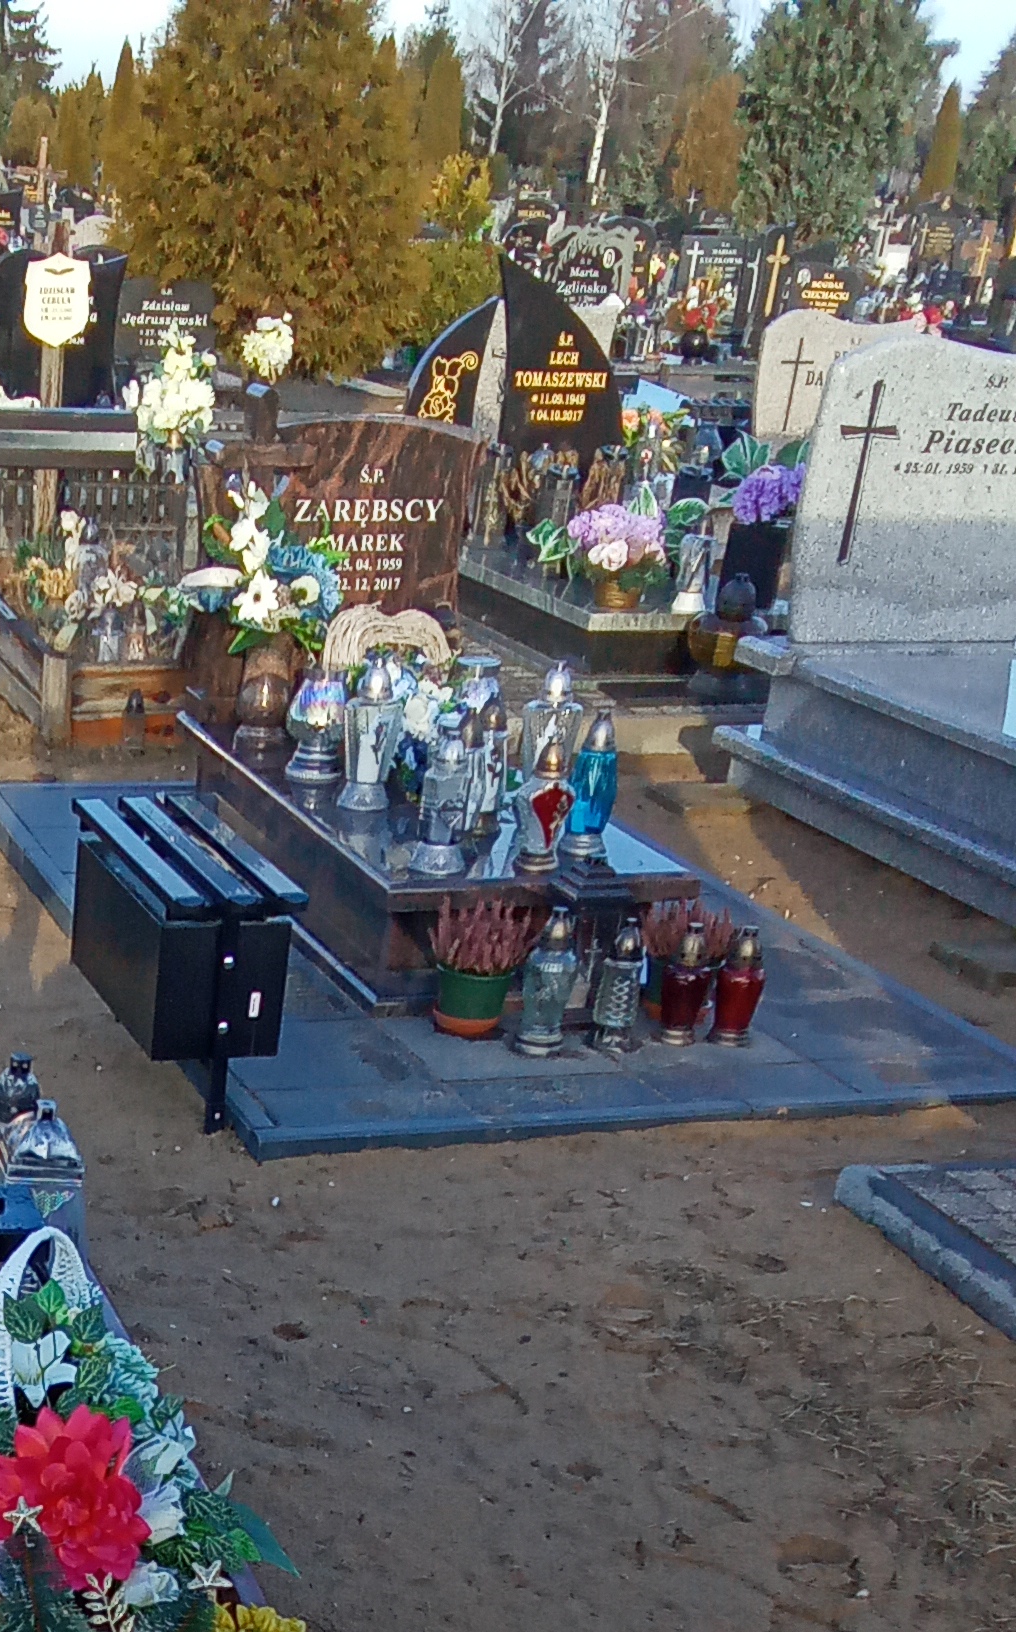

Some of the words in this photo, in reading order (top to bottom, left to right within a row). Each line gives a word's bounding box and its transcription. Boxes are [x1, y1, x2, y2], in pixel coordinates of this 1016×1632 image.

[569, 266, 599, 277] Marta
[556, 280, 607, 295] Zglińska
[549, 351, 580, 365] LECH
[515, 371, 608, 388] TOMASZEWSKI
[944, 402, 1016, 422] Tadeu
[920, 429, 1016, 455] Piasec
[294, 498, 444, 528] ZARĘBSCY
[327, 533, 405, 552] MAREK
[376, 558, 403, 571] 1959
[373, 576, 401, 591] 2017
